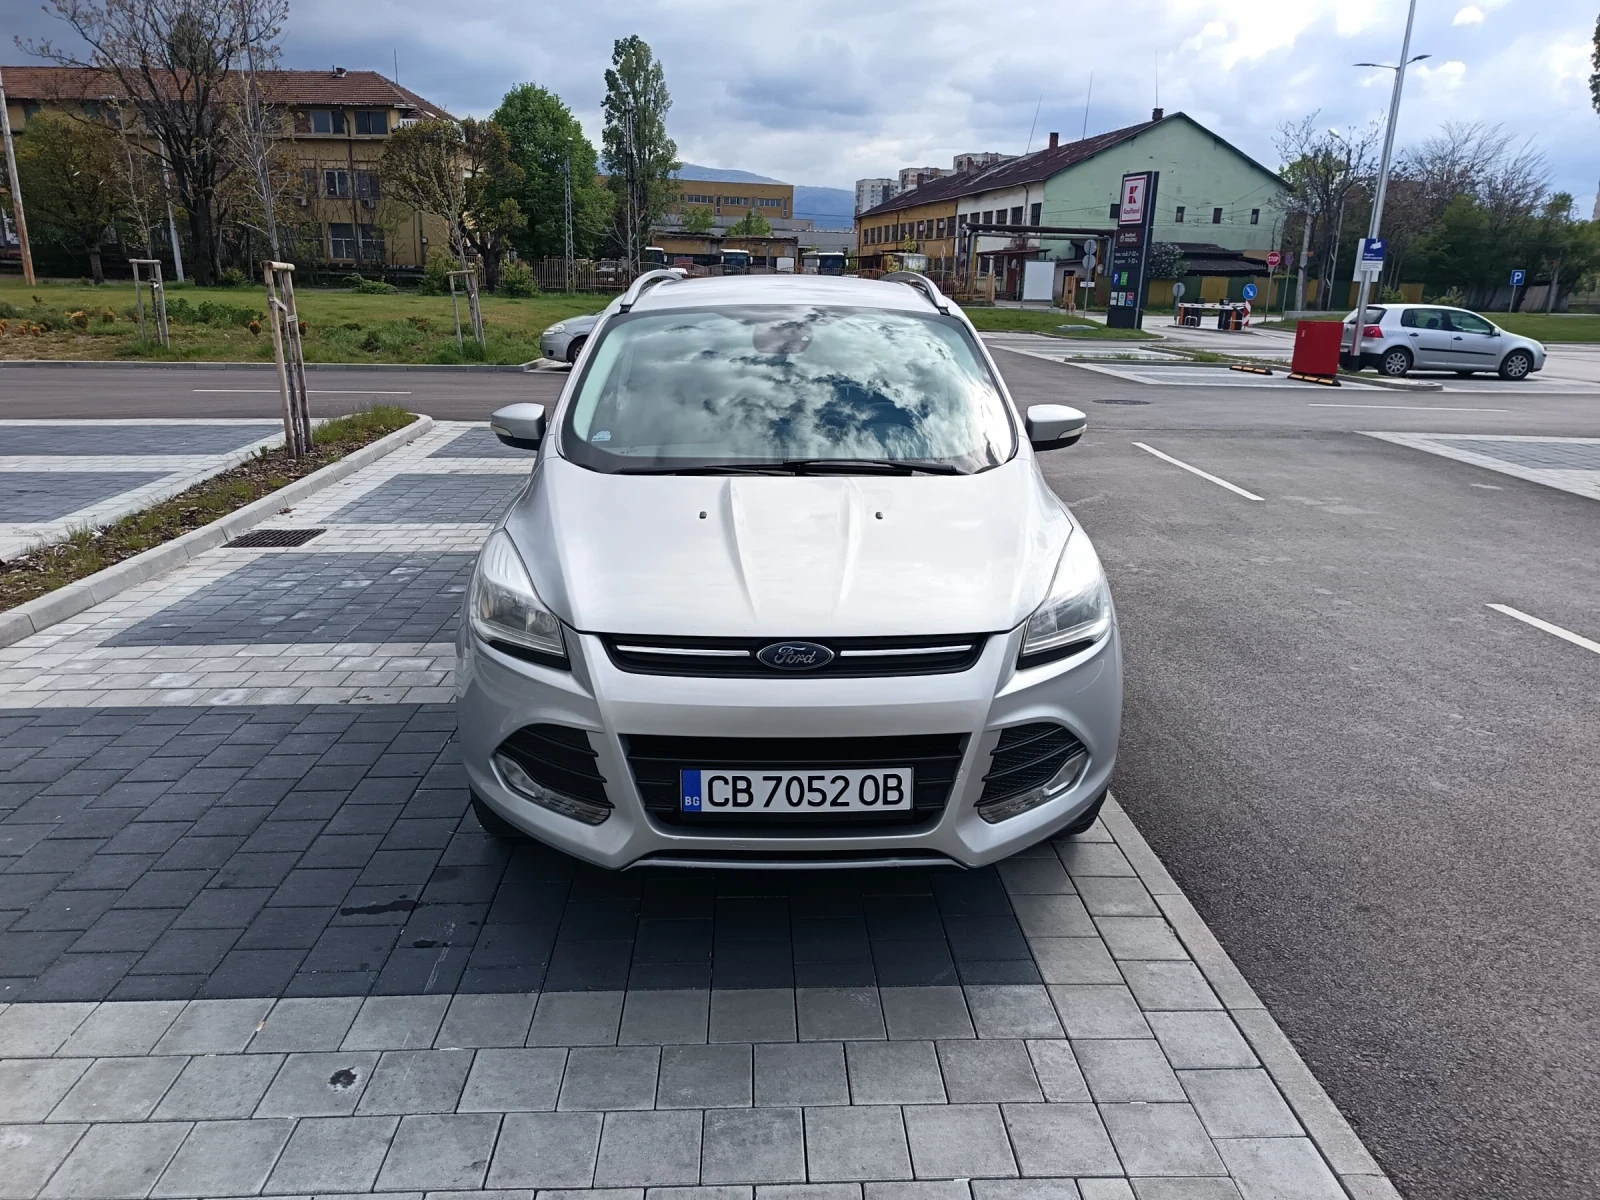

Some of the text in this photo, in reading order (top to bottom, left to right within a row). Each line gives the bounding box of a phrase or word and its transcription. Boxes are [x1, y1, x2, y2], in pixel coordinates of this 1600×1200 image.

[1128, 186, 1139, 204] K
[1113, 273, 1119, 283] P
[1513, 272, 1522, 284] P
[774, 646, 817, 664] Ford
[707, 773, 904, 808] CB 7052 OB
[685, 796, 700, 807] BG
